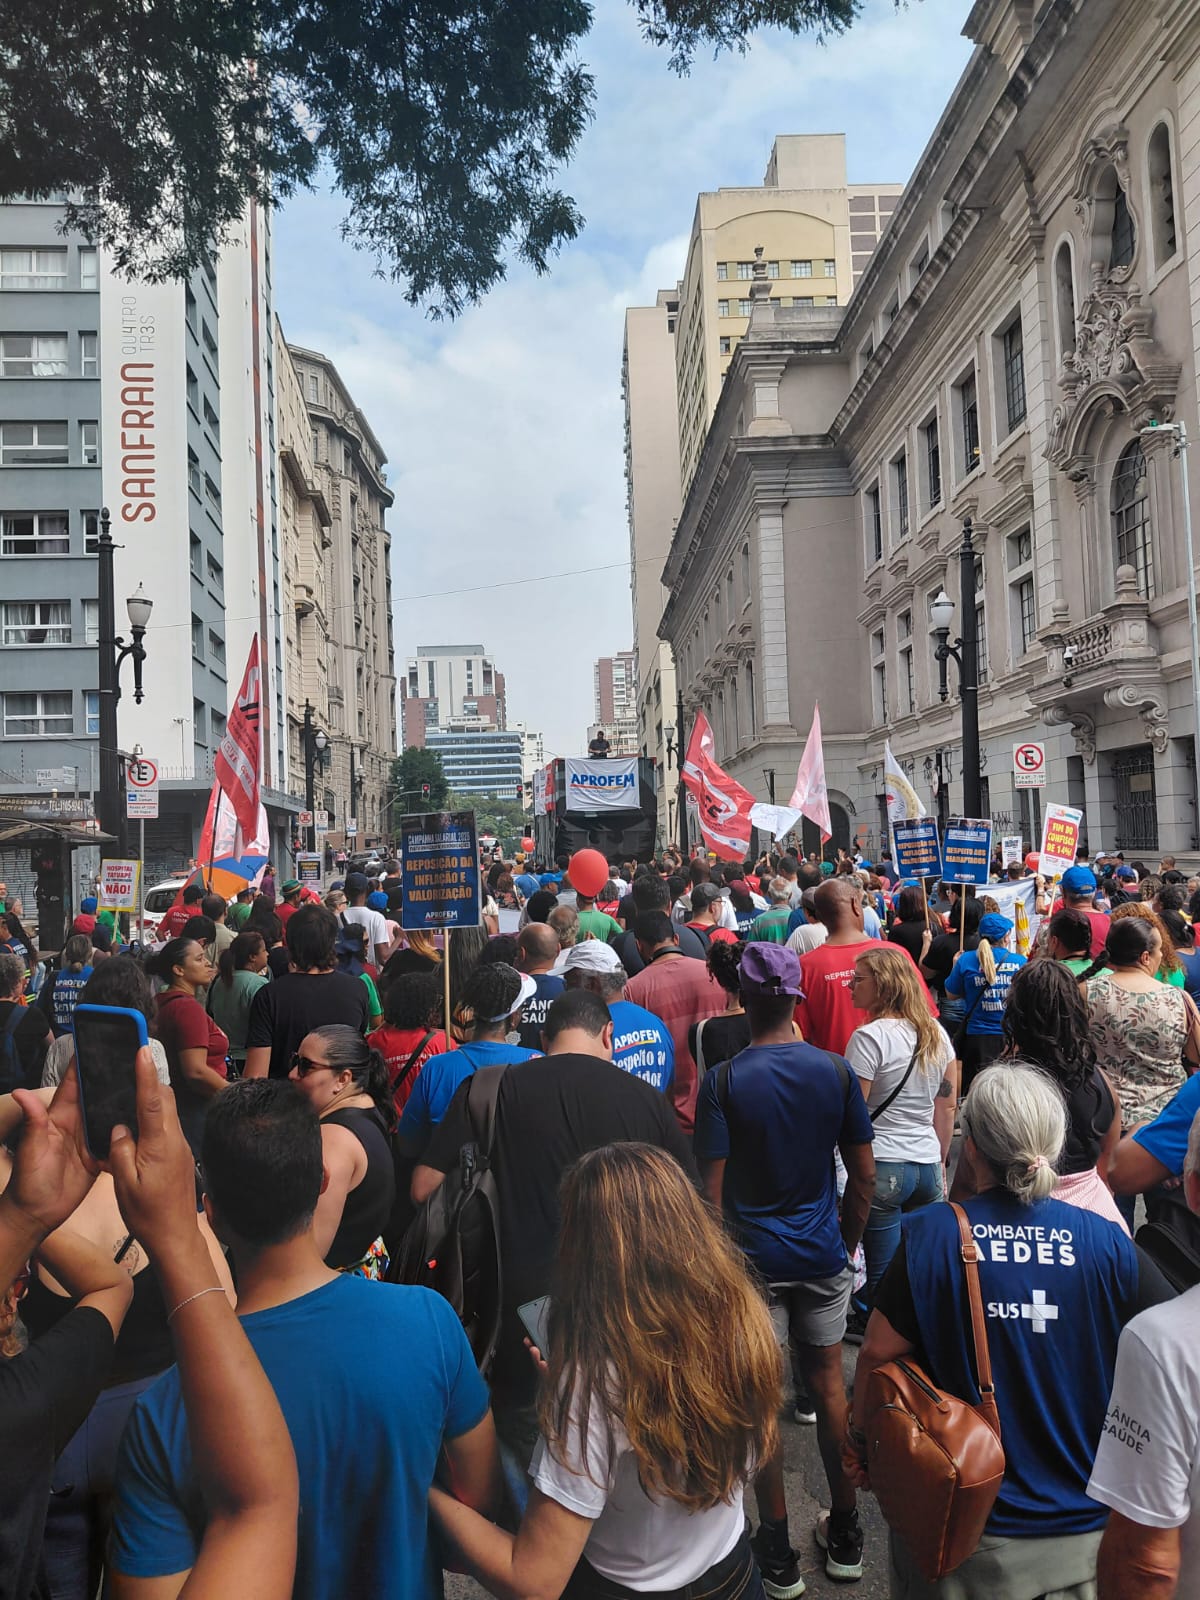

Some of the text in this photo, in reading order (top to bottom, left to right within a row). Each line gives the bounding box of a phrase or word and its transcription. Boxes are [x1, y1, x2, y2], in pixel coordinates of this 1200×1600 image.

[122, 296, 137, 355] QU4TRO
[140, 315, 156, 353] TR3S
[120, 363, 157, 522] SANFRAN
[137, 765, 148, 781] E
[571, 772, 635, 787] APROFEM
[406, 856, 474, 871] REPOSIÇÃO DA
[414, 871, 466, 886] INFLAÇÃO E
[106, 882, 131, 895] NÃO!
[408, 886, 472, 902] VALORIZAÇÃO
[425, 910, 458, 920] APROFEM
[521, 1010, 546, 1024] SAÚ
[614, 1029, 662, 1049] APROFEM
[1049, 1228, 1073, 1243] AO
[988, 1302, 1020, 1318] SUS
